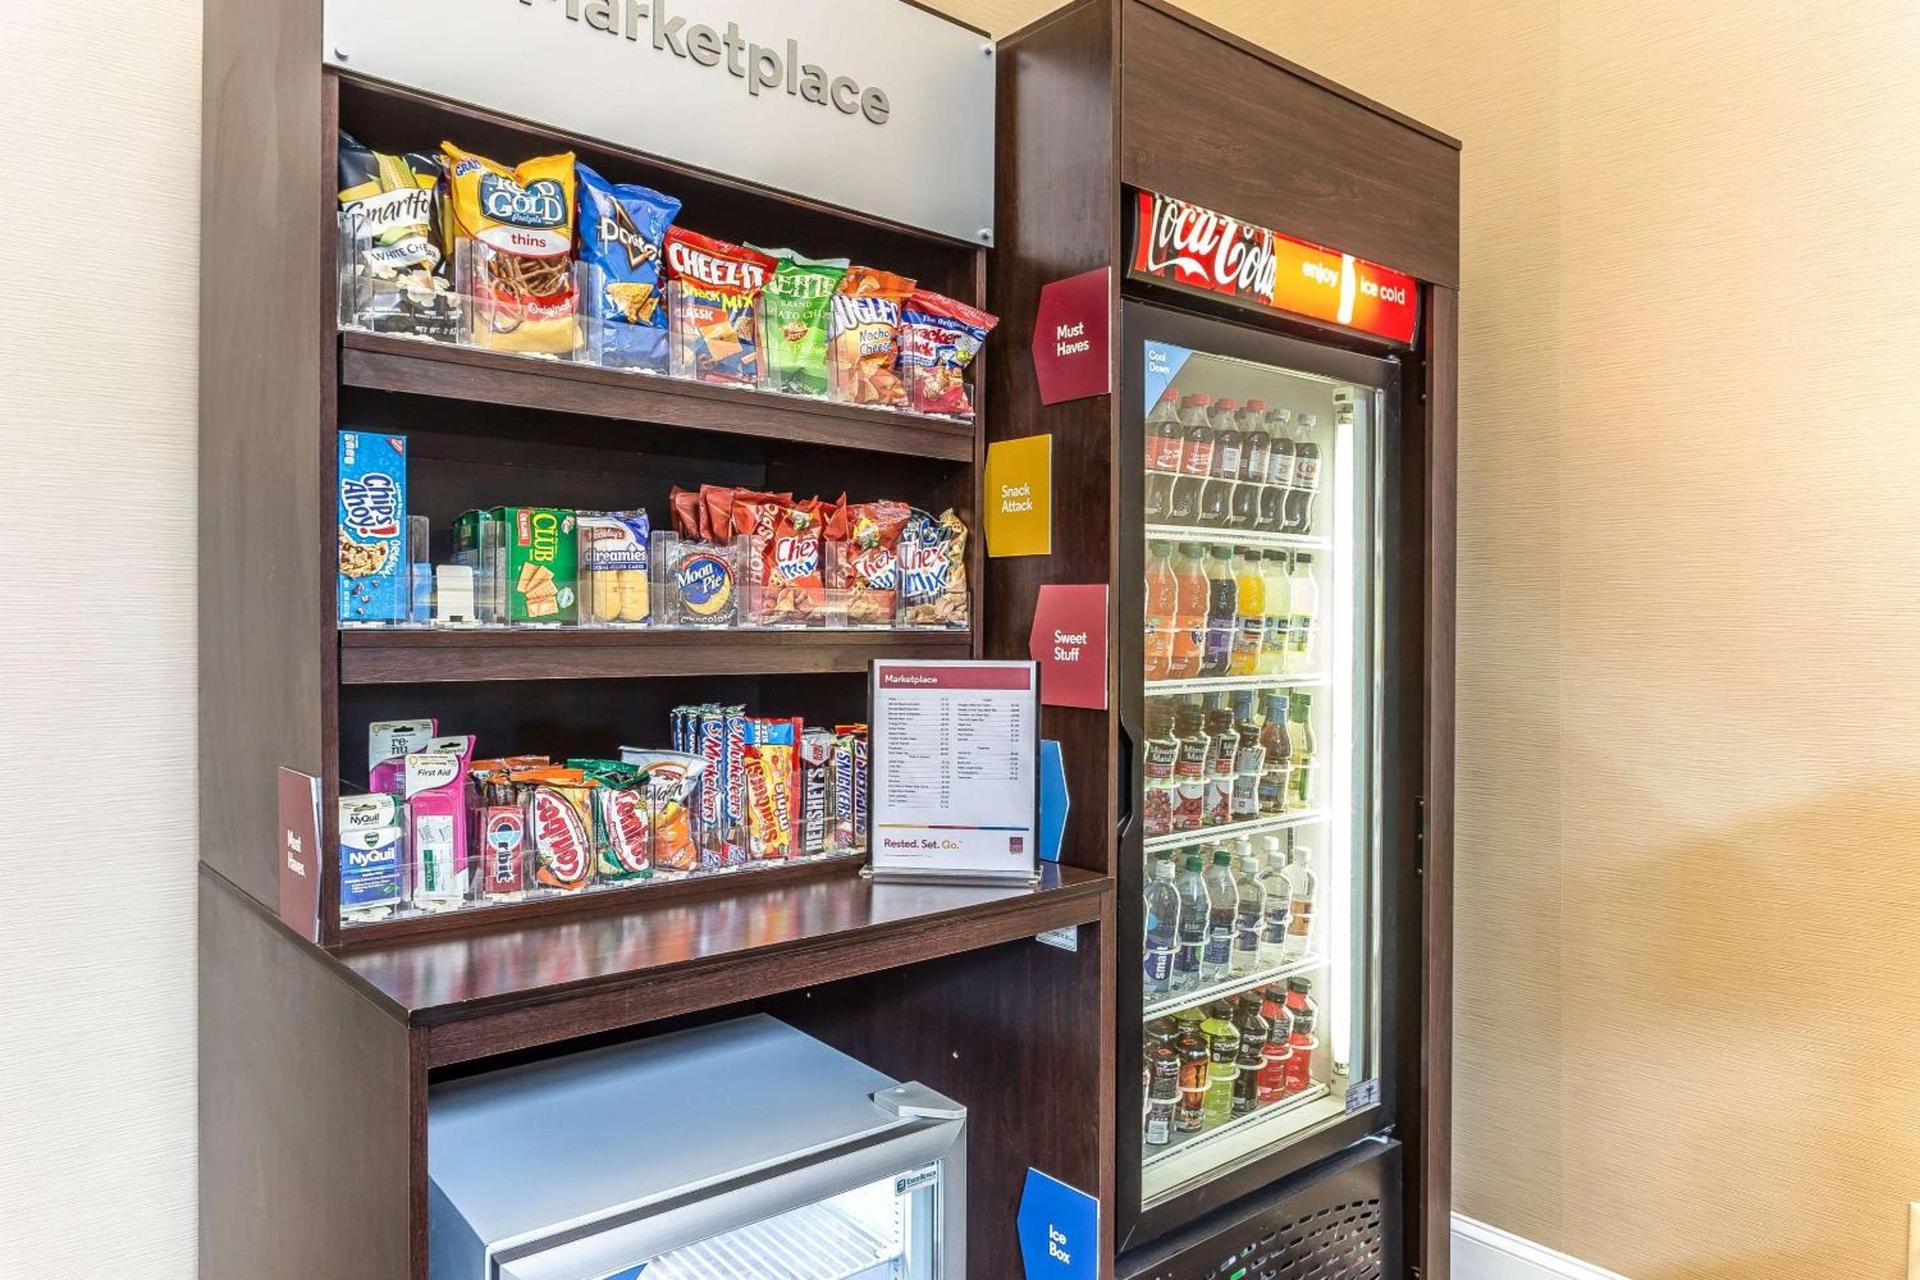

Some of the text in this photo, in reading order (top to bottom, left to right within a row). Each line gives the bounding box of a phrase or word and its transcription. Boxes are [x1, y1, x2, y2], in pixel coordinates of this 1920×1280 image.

[519, 0, 890, 124] arketplace
[495, 177, 555, 197] RD
[488, 192, 563, 221] GOLD
[511, 234, 547, 248] thins
[372, 248, 407, 262] WHITE
[670, 242, 764, 289] CHEEZ-IT
[1302, 261, 1339, 288] enjoy
[1360, 276, 1406, 305] ice cold
[860, 328, 890, 342] Nacho
[1057, 322, 1085, 341] Must
[860, 342, 891, 354] Cheese
[1056, 339, 1091, 357] Haves
[1148, 350, 1167, 362] Cool
[1148, 362, 1171, 375] Down
[362, 473, 397, 527] Chips
[1001, 483, 1031, 499] Snack
[1001, 498, 1034, 513] Attack
[757, 503, 780, 540] SPIC
[533, 513, 557, 562] CLUB
[777, 537, 818, 562] Chex
[675, 563, 714, 589] Moon
[702, 573, 723, 594] Pie
[1054, 629, 1088, 645] Sweet
[1054, 646, 1080, 661] Stuff
[884, 674, 938, 685] Marketplace
[728, 732, 745, 818] Musketeers
[836, 751, 852, 820] SNICKERS
[773, 781, 790, 832] minis
[806, 767, 825, 851] HERSHEY'S
[350, 813, 380, 825] NyQuil
[536, 797, 579, 877] Combos
[884, 838, 960, 850] Rested. Set. Go.
[349, 847, 395, 866] NyQuil
[1155, 945, 1169, 980] smat
[1049, 1223, 1067, 1245] Ice
[1048, 1241, 1071, 1265] Box
